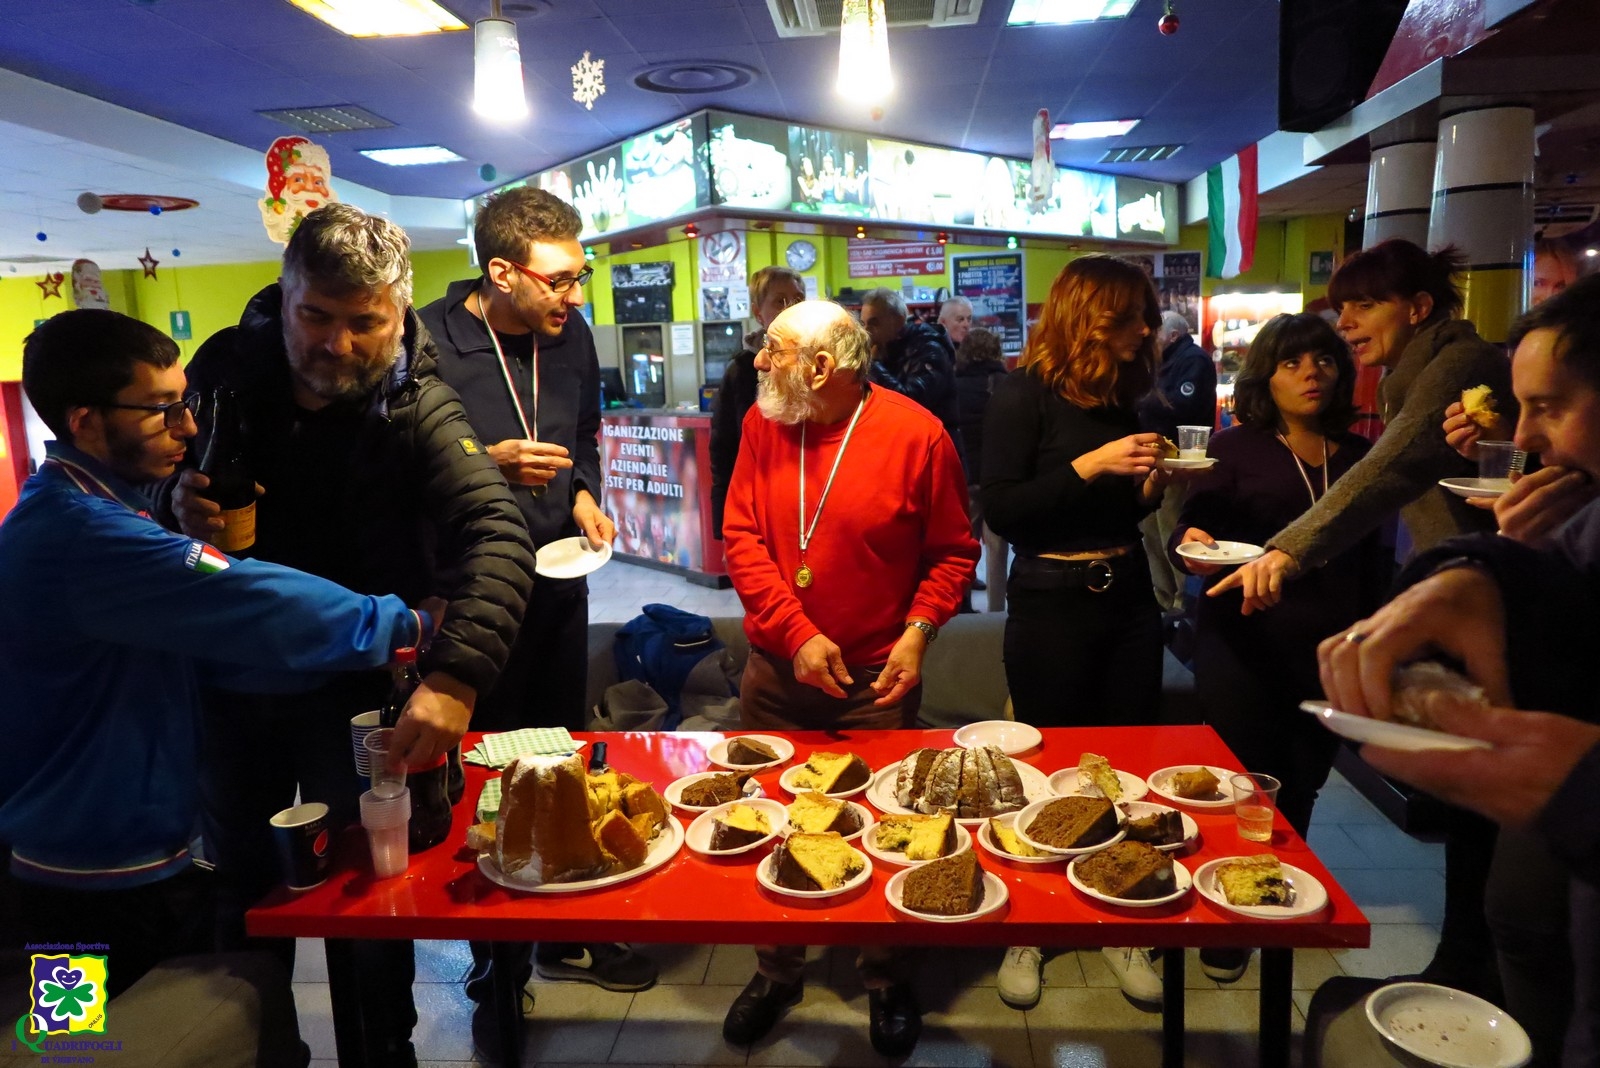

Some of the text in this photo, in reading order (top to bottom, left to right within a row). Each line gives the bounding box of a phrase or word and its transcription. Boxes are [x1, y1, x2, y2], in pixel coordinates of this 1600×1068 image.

[603, 425, 684, 442] RGANIZZAZIONE
[620, 443, 655, 457] EVENTI
[611, 459, 668, 477] AZIENDALIE
[605, 476, 684, 498] ESTE PER ADULTI
[185, 542, 203, 567] ITALIA
